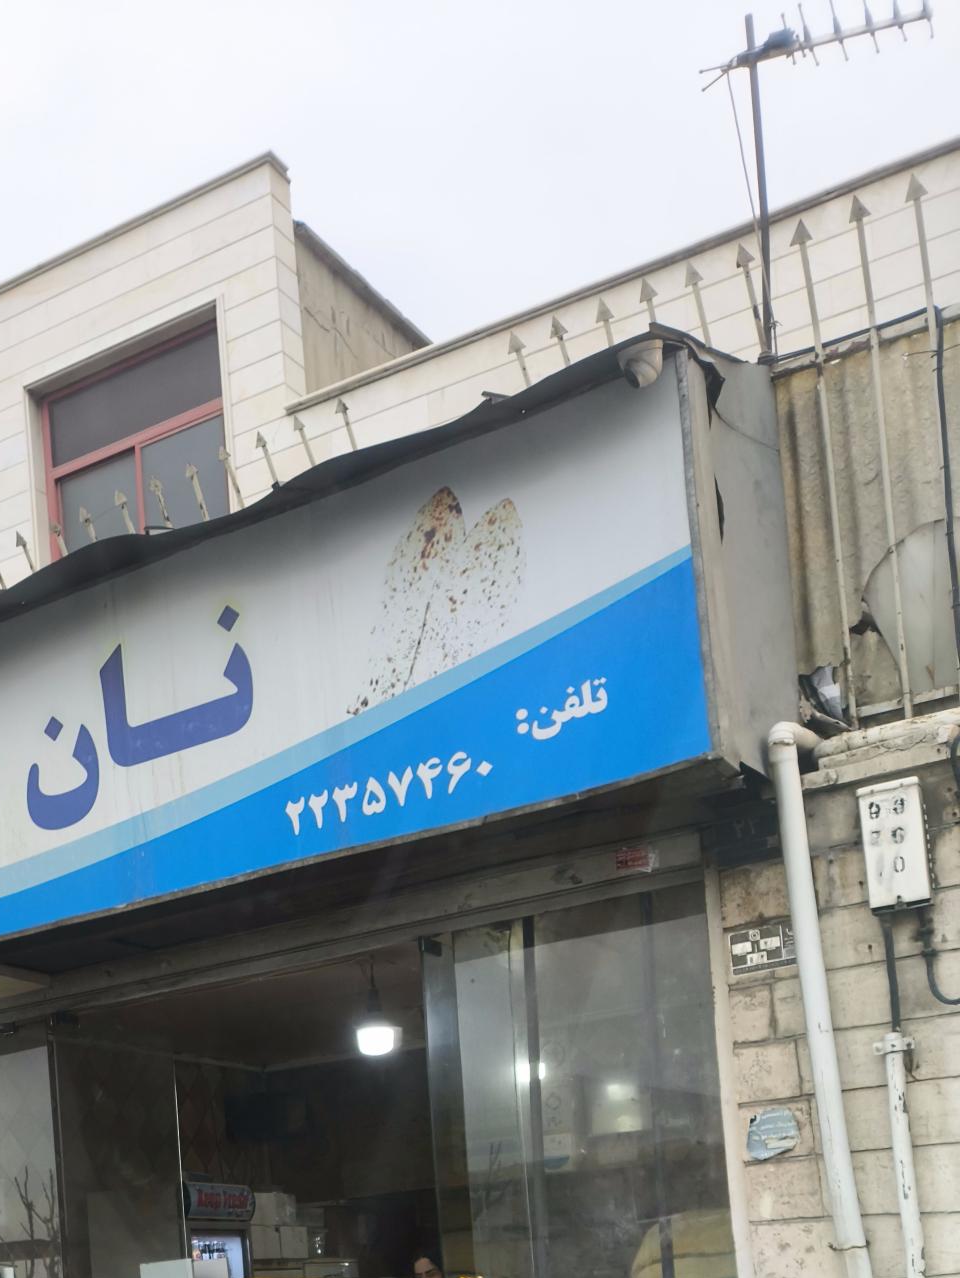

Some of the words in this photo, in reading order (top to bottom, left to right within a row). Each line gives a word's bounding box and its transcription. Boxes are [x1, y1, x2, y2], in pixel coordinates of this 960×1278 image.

[26, 605, 254, 831] نان
[516, 677, 608, 740] تلفن:
[285, 751, 493, 836] ۲۲۳۵۷۴۶۰
